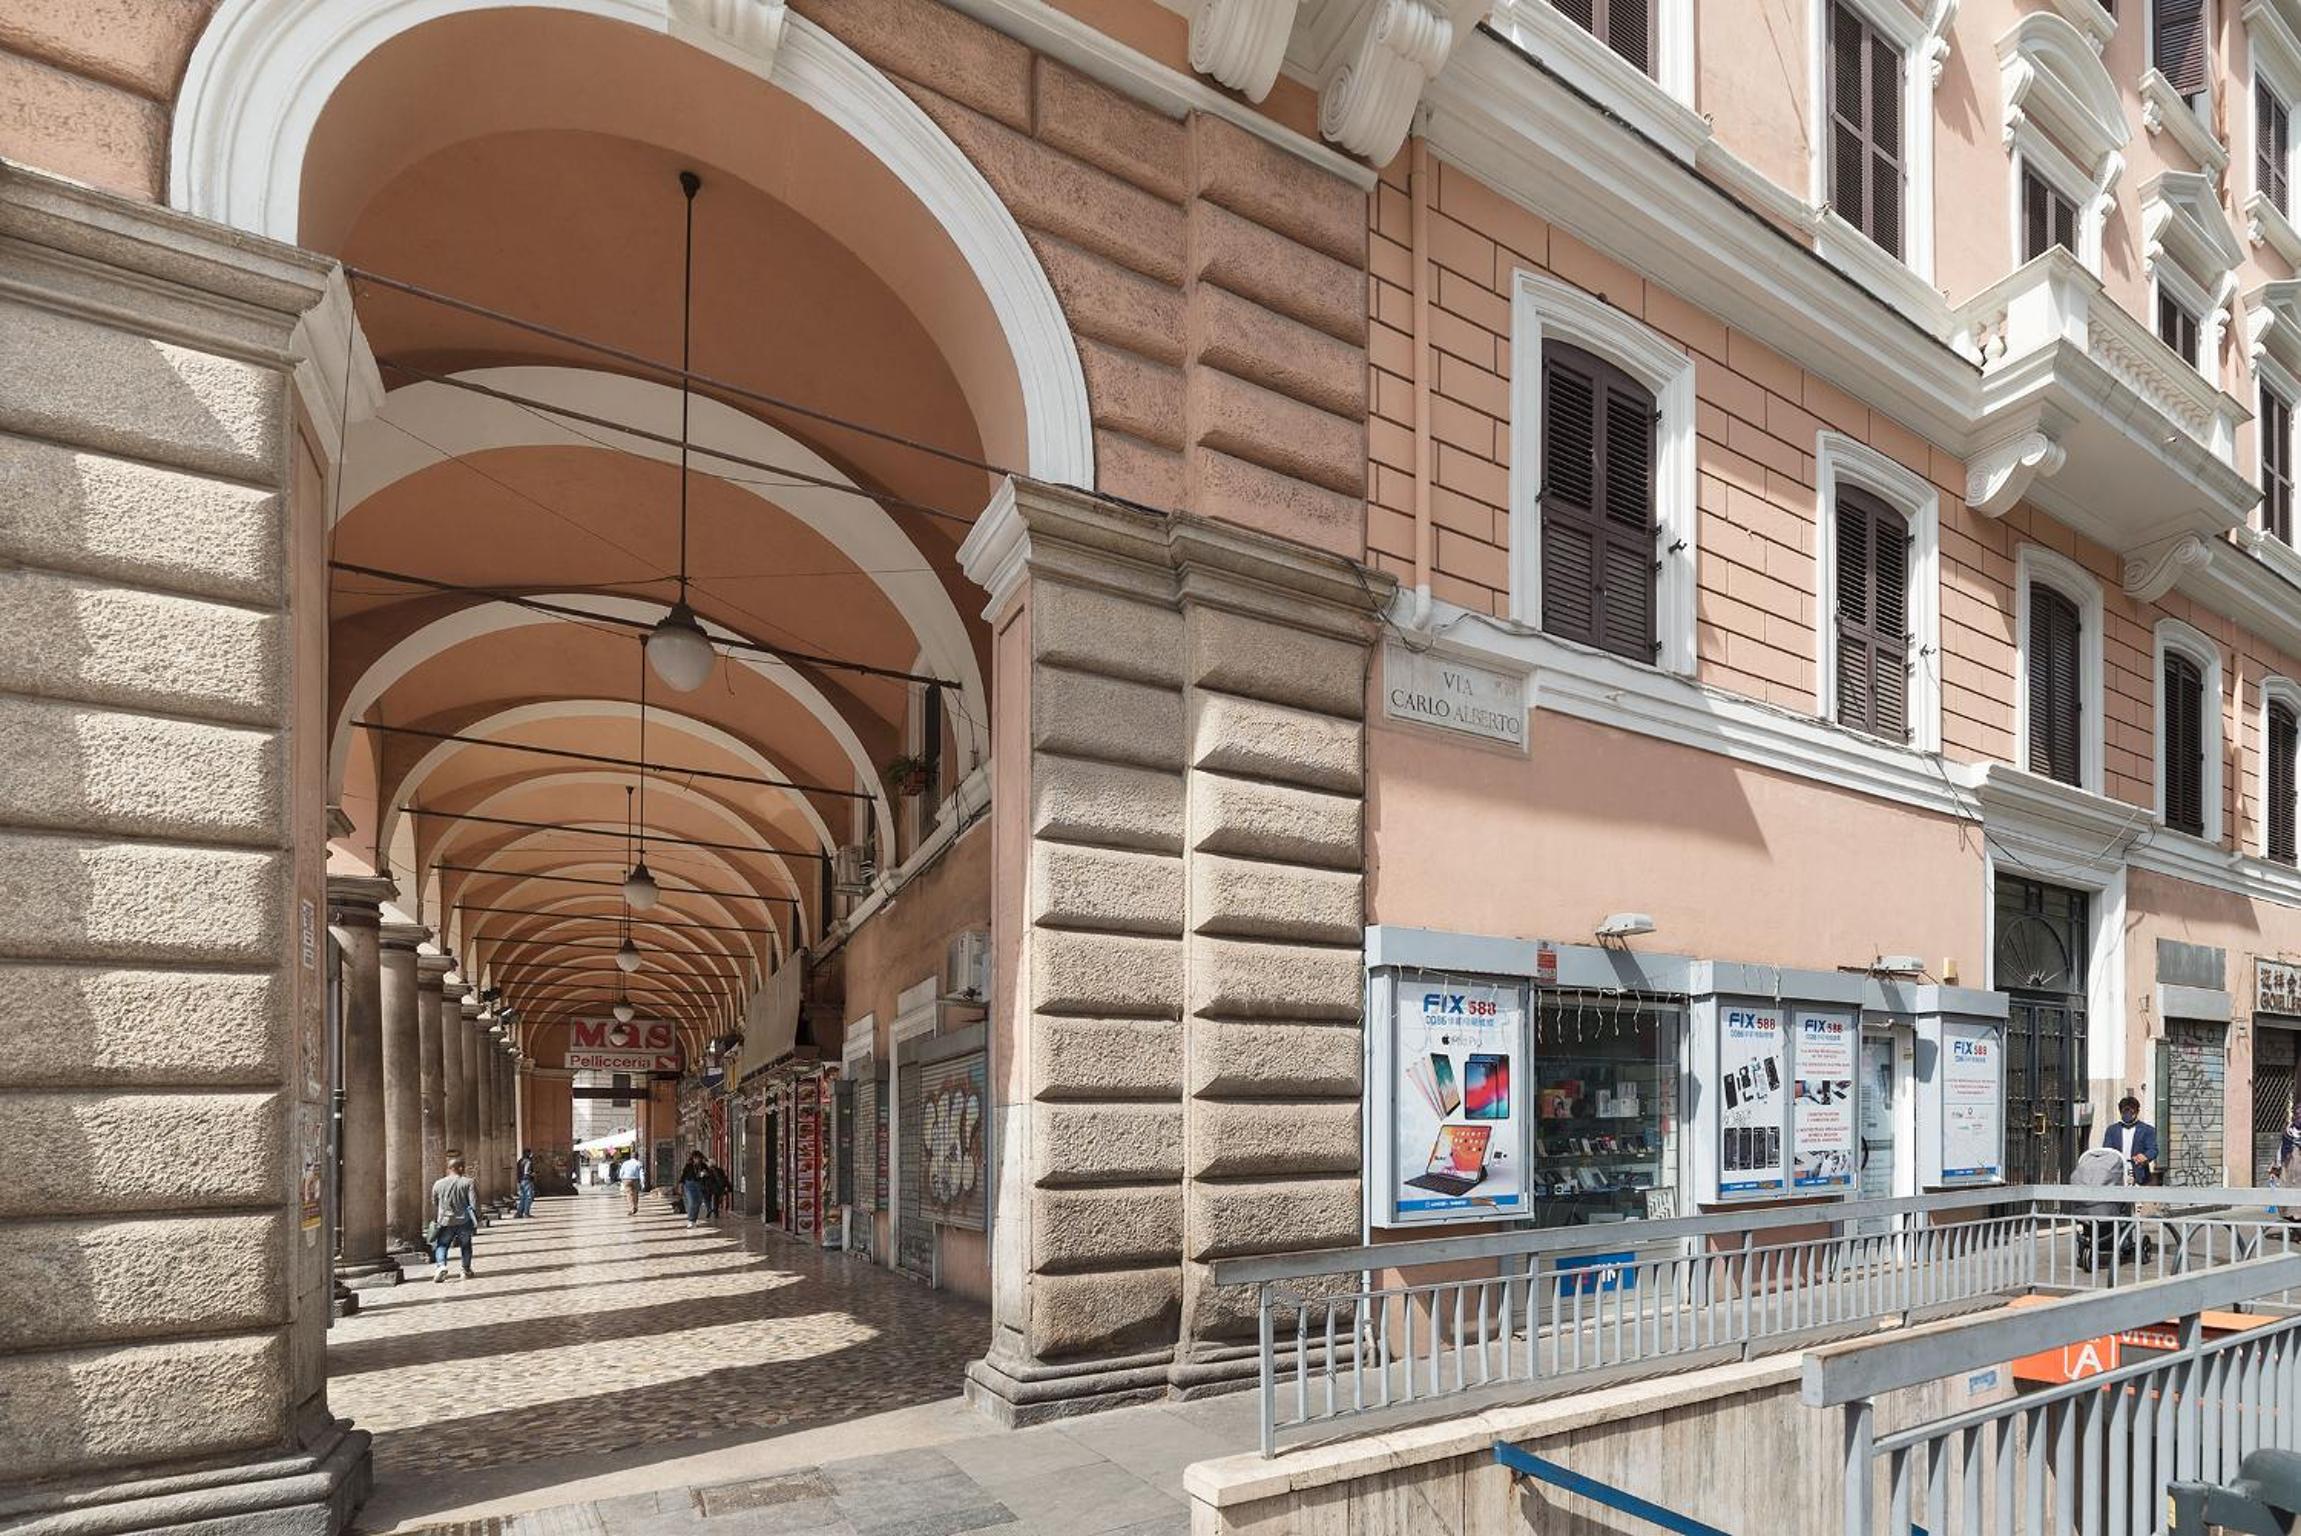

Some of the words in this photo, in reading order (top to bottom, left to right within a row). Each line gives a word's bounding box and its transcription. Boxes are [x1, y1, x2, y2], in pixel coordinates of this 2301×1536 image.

[1442, 671, 1473, 696] VIA
[1391, 688, 1450, 718] CARLO
[1453, 705, 1520, 734] ALBERTO
[1423, 994, 1466, 1014] FIX
[1468, 1001, 1497, 1015] 588
[1729, 1012, 1756, 1029] FIX
[1757, 1018, 1776, 1030] 588
[1805, 1019, 1826, 1033] FIX
[1954, 1041, 1972, 1055] FIX
[570, 1055, 651, 1069] Pellicceria
